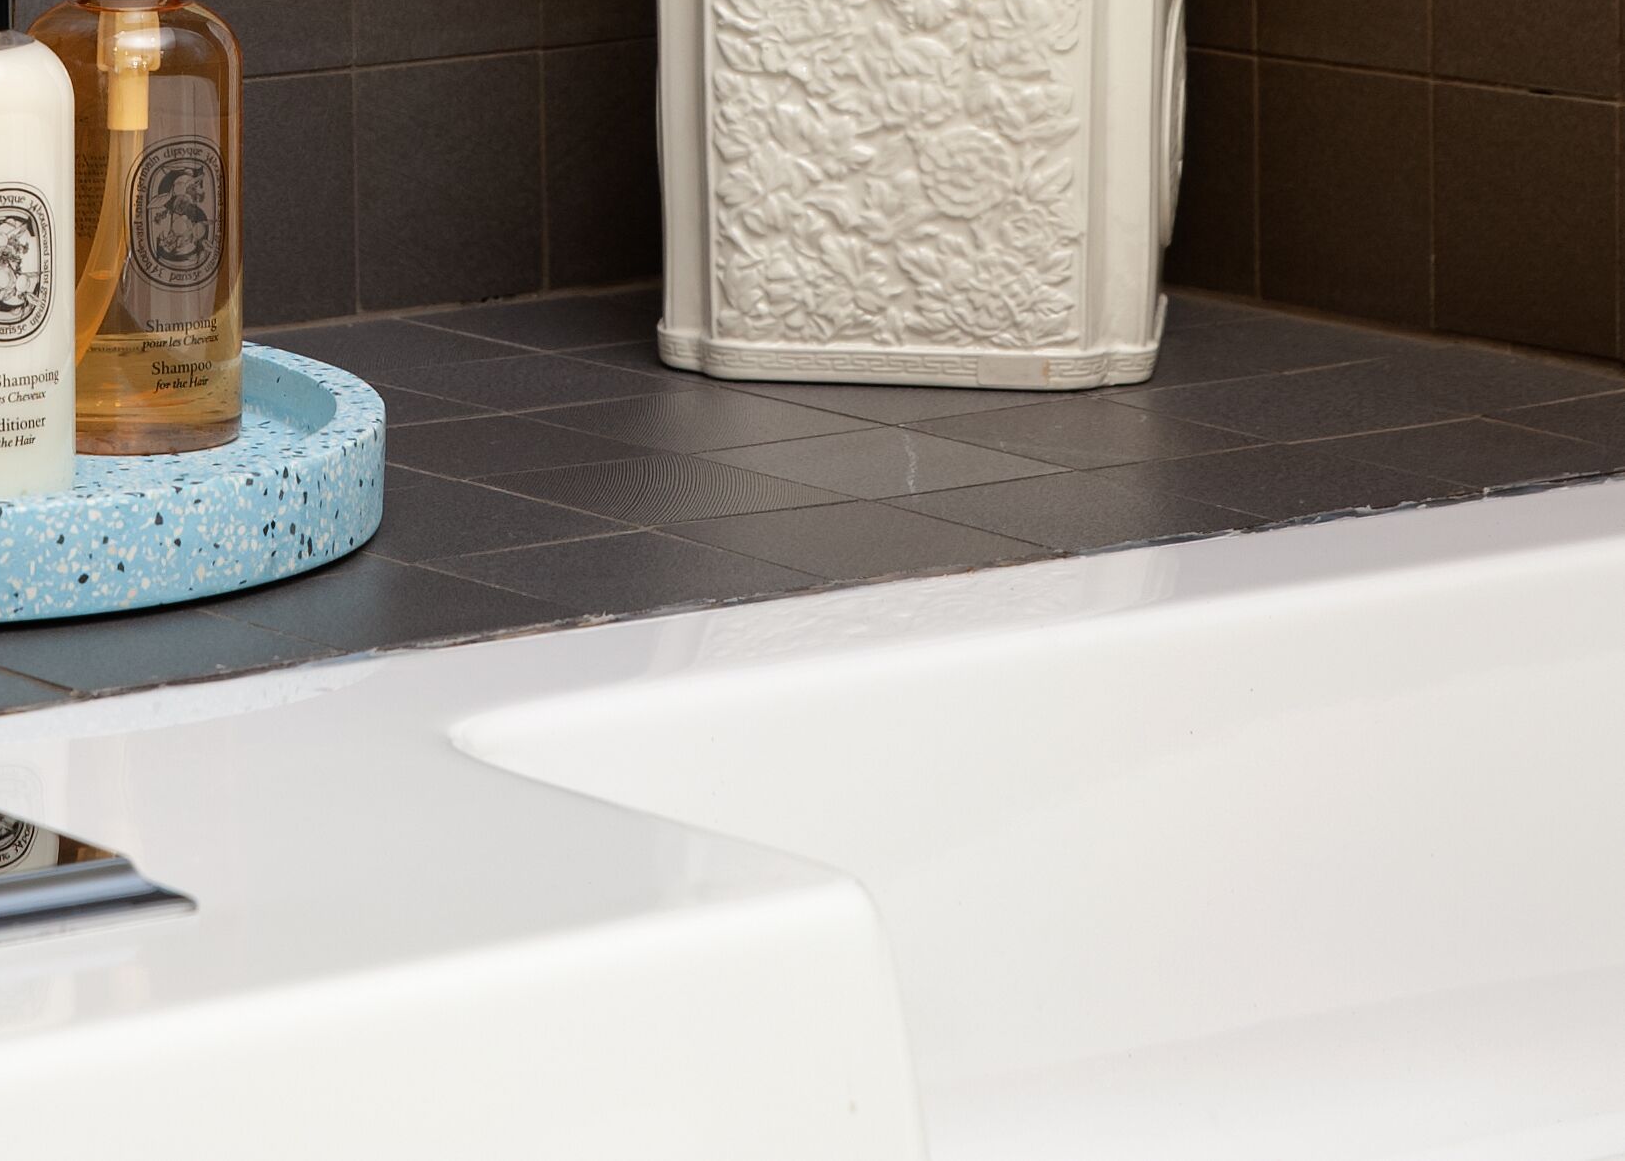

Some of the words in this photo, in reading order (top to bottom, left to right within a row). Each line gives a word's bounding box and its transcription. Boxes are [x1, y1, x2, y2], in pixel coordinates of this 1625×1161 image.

[145, 317, 217, 335] Shampoing
[142, 340, 167, 352] pour
[169, 336, 182, 348] les
[183, 334, 219, 347] Cheveux
[151, 360, 212, 376] Shampoo
[153, 378, 171, 394] for
[173, 378, 188, 389] the
[189, 375, 209, 388] Hair
[7, 390, 47, 403] Cheveux
[14, 434, 36, 447] Hair
